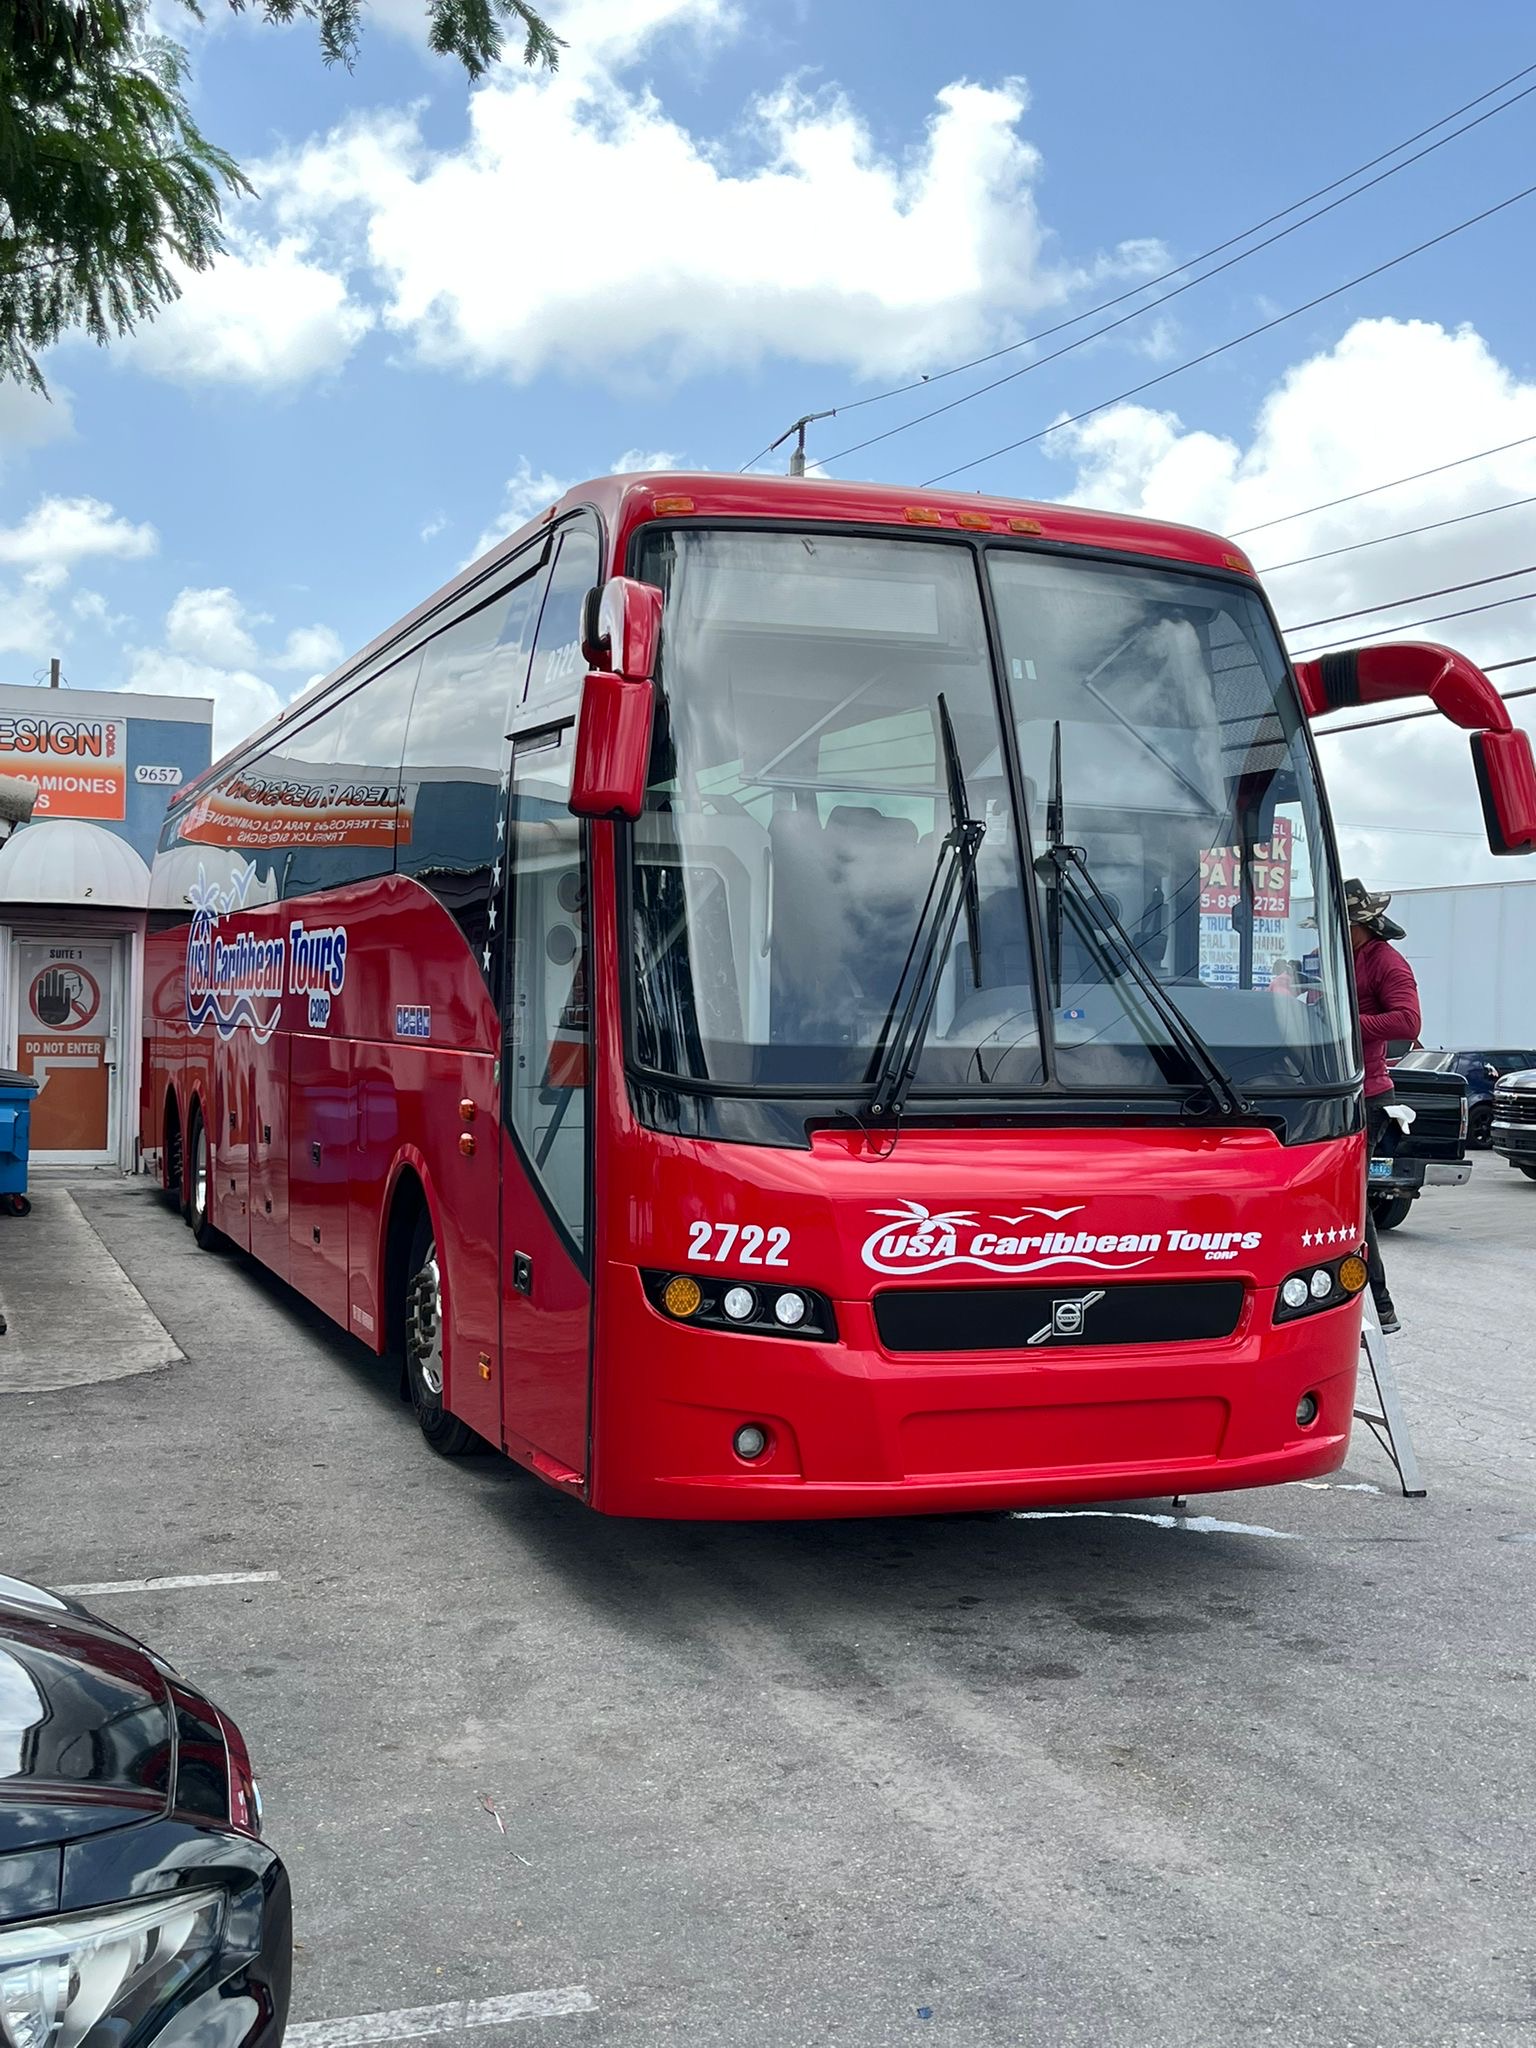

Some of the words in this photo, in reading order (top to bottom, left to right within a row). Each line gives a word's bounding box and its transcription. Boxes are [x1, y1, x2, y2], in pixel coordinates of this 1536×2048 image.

[138, 767, 178, 782] 9657
[85, 888, 93, 897] 2
[50, 949, 75, 960] SUITE
[78, 950, 83, 960] 1
[190, 940, 212, 995] USA
[213, 932, 285, 997] Caribbean
[289, 921, 347, 996] Tours
[309, 997, 330, 1025] CORP
[26, 1042, 41, 1054] DO
[43, 1042, 64, 1054] NOT
[67, 1042, 101, 1054] ENTER
[687, 1220, 791, 1267] 2722
[879, 1233, 958, 1258] USA
[970, 1231, 1162, 1257] Caribbean
[1166, 1229, 1262, 1252] Tours
[1204, 1250, 1239, 1261] CORP
